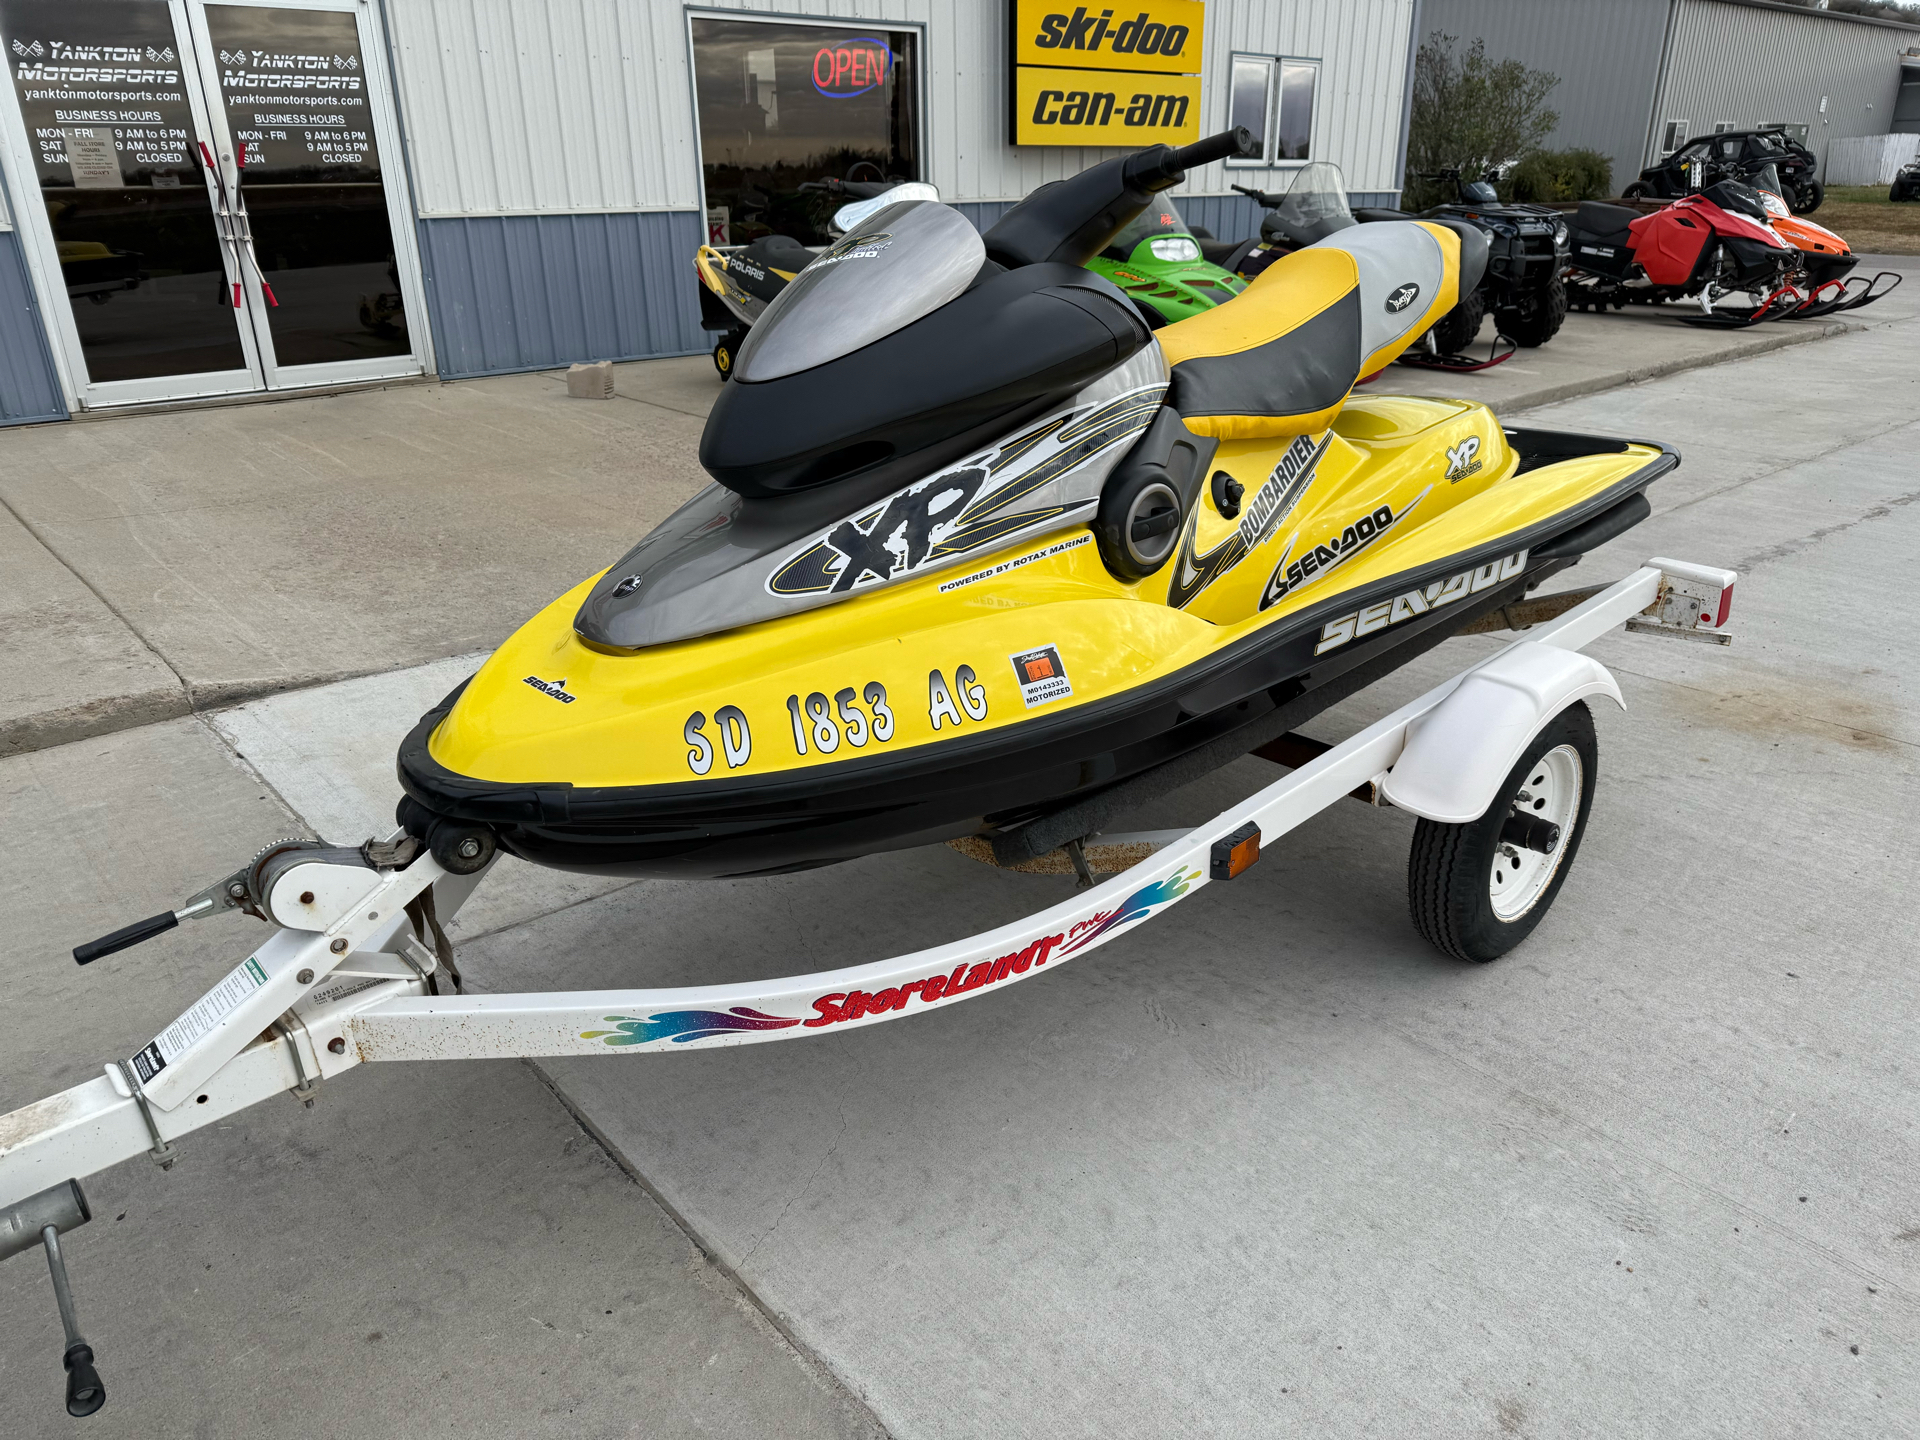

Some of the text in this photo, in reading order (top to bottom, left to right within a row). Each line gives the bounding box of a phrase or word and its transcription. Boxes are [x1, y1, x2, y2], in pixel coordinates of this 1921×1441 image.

[1035, 7, 1189, 56] ski-doo
[49, 41, 142, 62] YANKTON
[251, 50, 329, 69] YANKTON
[17, 62, 178, 84] MOTORSPORTS
[813, 48, 885, 87] OPEN
[223, 70, 361, 89] MOTORSPORTS
[24, 88, 181, 102] yanktonmotorsports.com
[229, 94, 362, 106] yanktonmotorsports.com
[55, 110, 162, 121] BUSINESS HOURS
[1032, 90, 1189, 127] can-am
[254, 114, 345, 124] BUSINESS HOURS
[36, 128, 65, 138] MON
[74, 128, 94, 138] FRI
[114, 128, 187, 139] 9 AM to 6 PM
[237, 131, 262, 140] MON
[270, 131, 287, 140] FRI
[304, 131, 367, 140] 9 AM to 6 PM
[40, 141, 62, 151] SAT
[114, 141, 187, 151] 9 AM to 5 PM
[306, 143, 369, 151] 9 AM to 5 PM
[43, 153, 69, 163] SUN
[136, 153, 182, 163] CLOSED
[244, 154, 265, 163] SUN
[322, 154, 362, 163] CLOSED
[730, 258, 765, 281] POLARIS
[1445, 436, 1480, 479] XP
[1240, 435, 1317, 547] BOMBARDIER
[828, 465, 989, 594] XP
[940, 536, 1091, 593] POWERED BY ROTAX MARINE
[1026, 686, 1071, 704] MOTORIZED
[684, 664, 988, 776] SD 1853 AG
[1069, 910, 1111, 938] PWC
